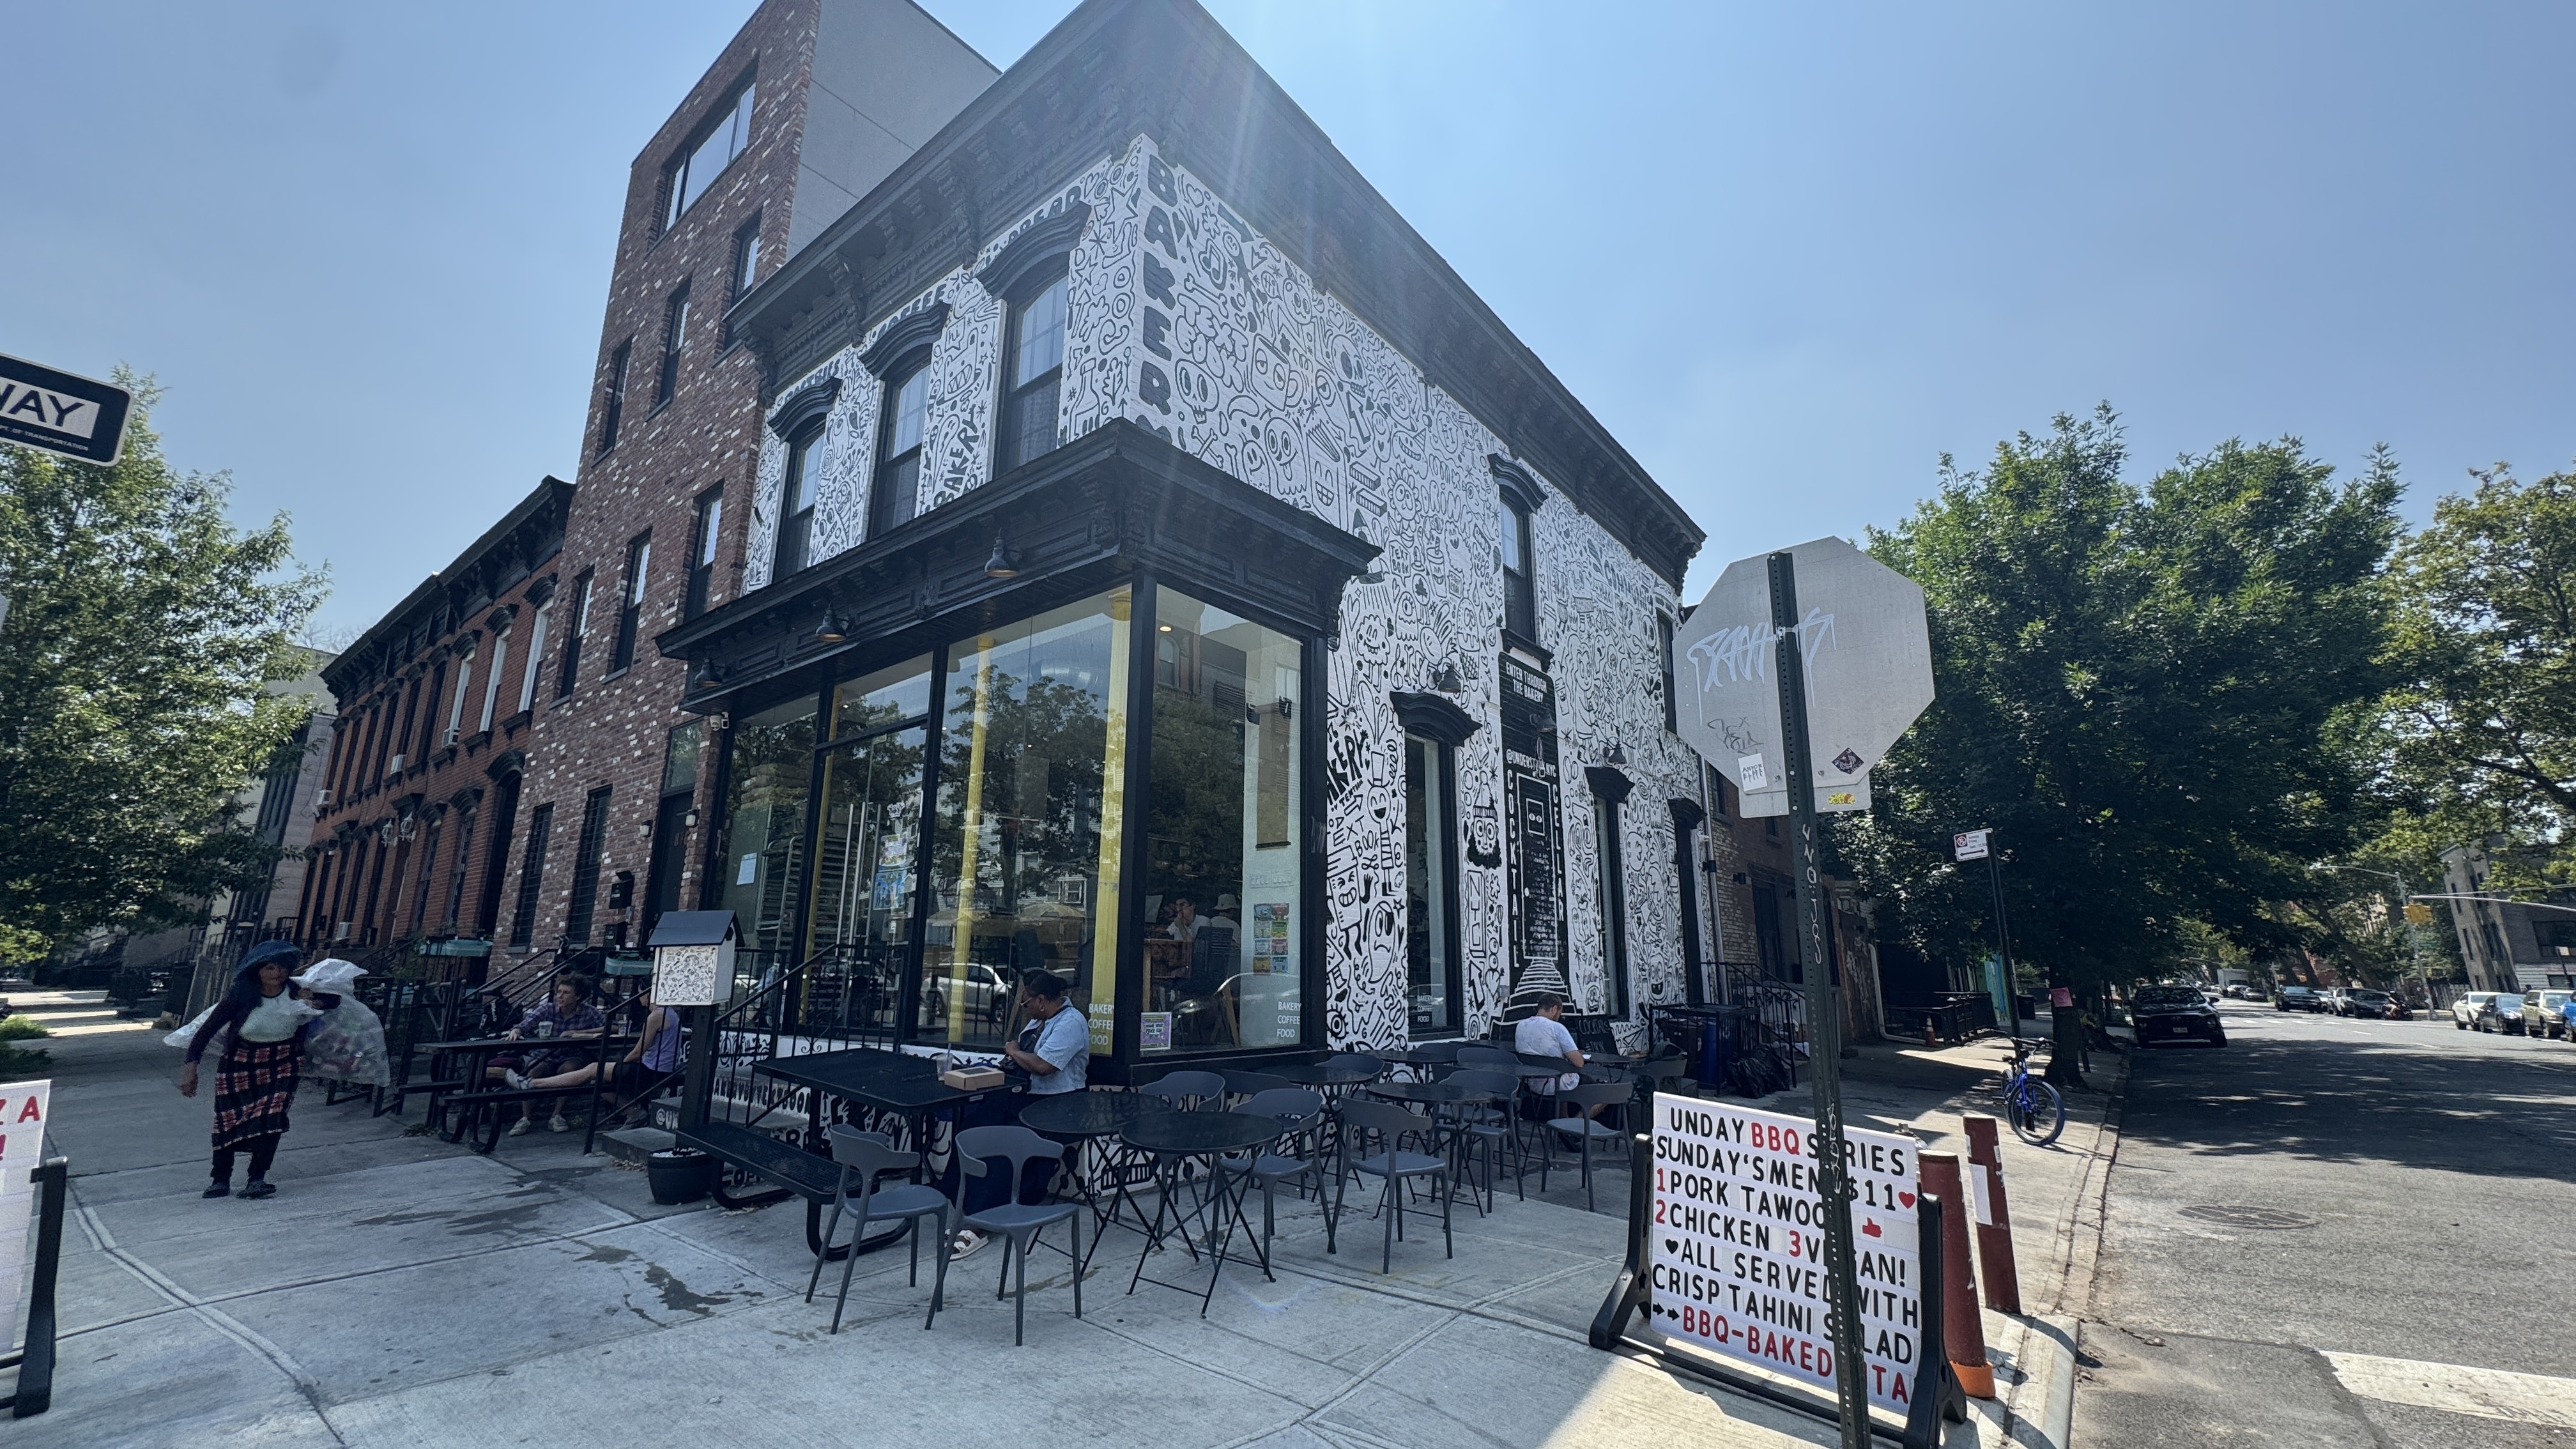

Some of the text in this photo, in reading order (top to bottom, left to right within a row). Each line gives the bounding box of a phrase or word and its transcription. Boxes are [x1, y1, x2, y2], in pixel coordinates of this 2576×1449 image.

[25, 431, 89, 451] TRANSPORTATION
[1278, 1002, 1301, 1011] BAKERY
[1278, 1015, 1300, 1025] COFFEE
[1277, 1029, 1295, 1038] FOOD
[1670, 1107, 1905, 1176] UNDAY BBQ SRIES
[1769, 1159, 1822, 1195] MEN
[1670, 1170, 1729, 1207] PORK
[1740, 1184, 1825, 1229] TAWOO
[1669, 1202, 1769, 1251] CHICKEN
[1805, 1235, 1905, 1287] VAN!
[1681, 1238, 1721, 1273] ALL
[1652, 1263, 1912, 1365] CRISP TAHINI SLAD
